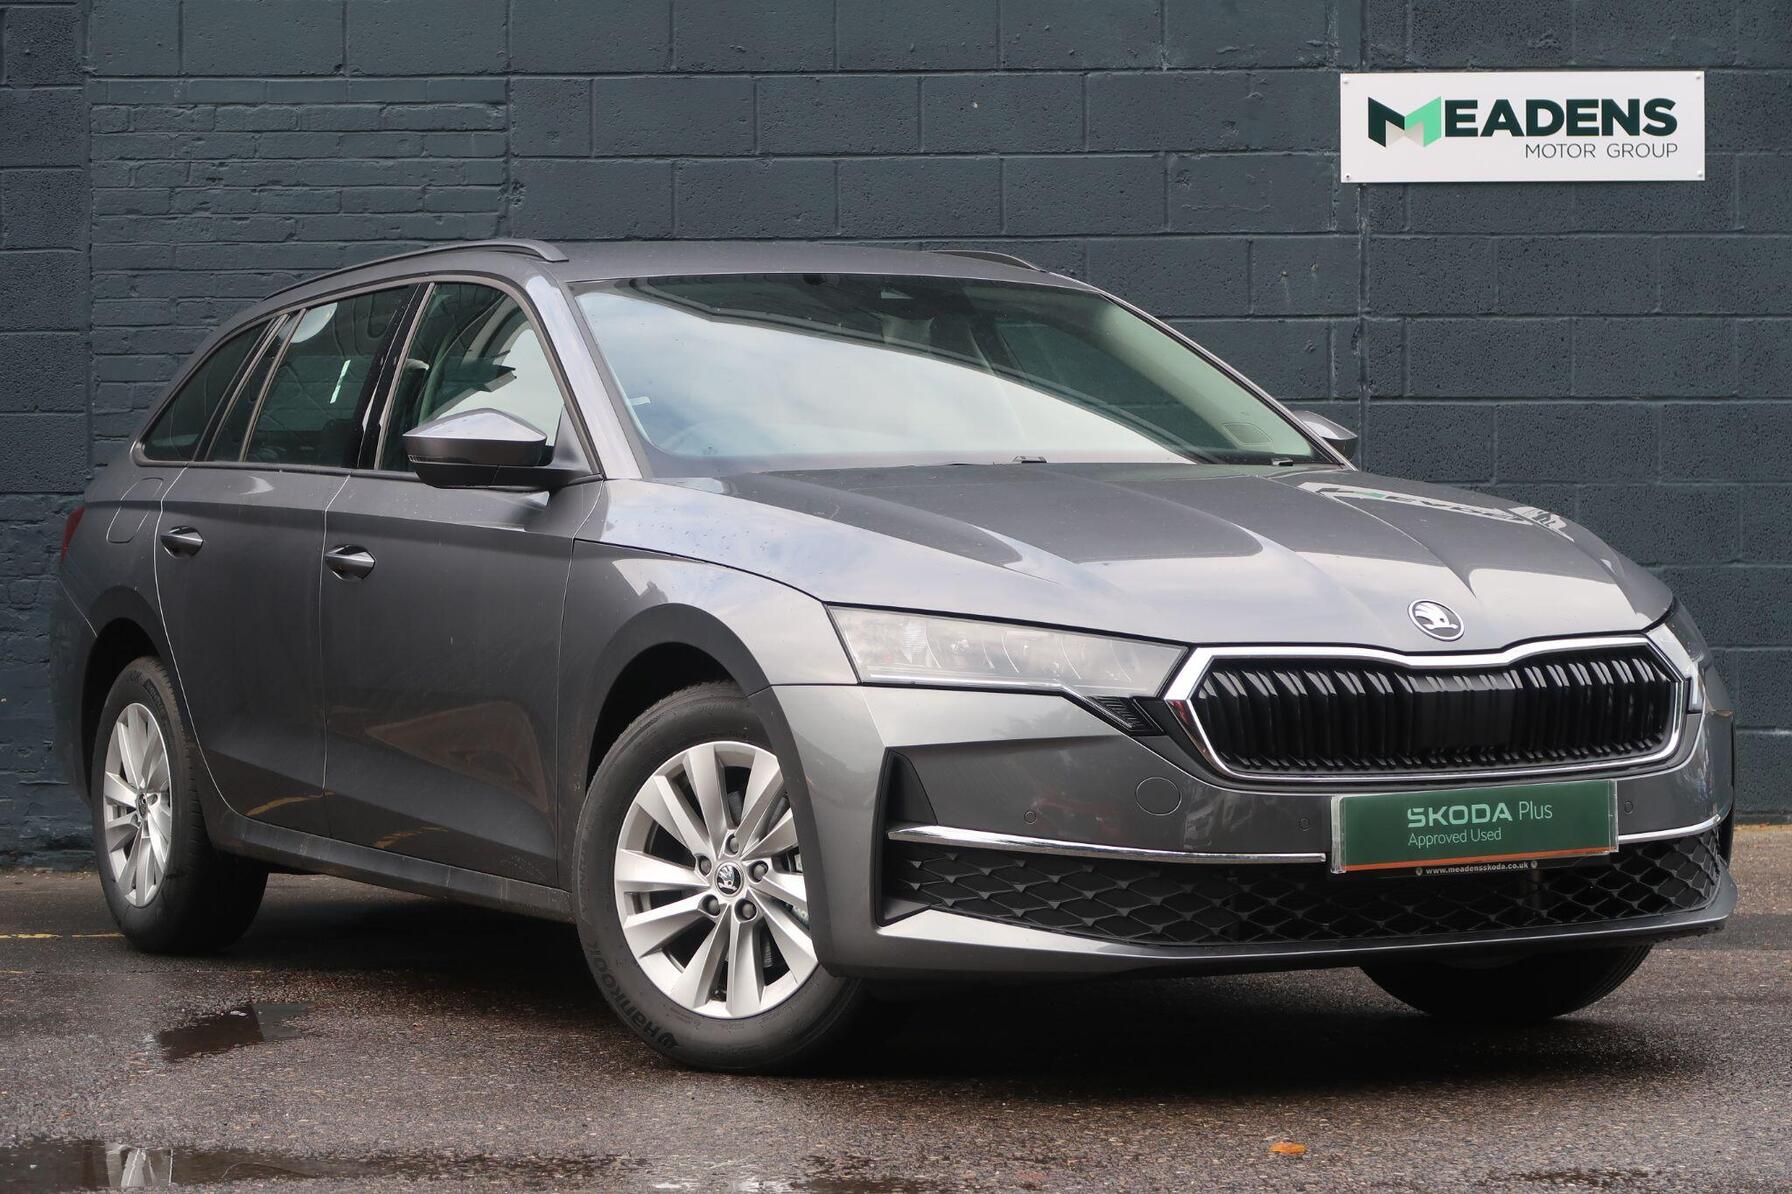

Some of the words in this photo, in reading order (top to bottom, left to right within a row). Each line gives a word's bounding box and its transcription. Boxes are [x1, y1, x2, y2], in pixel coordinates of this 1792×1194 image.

[1368, 96, 1678, 147] MEADENS
[1525, 143, 1596, 159] MOTOR
[1606, 142, 1678, 159] GROUP
[1518, 800, 1553, 821] Plus
[1407, 829, 1468, 849] Approved
[1470, 827, 1502, 842] Used
[1425, 862, 1529, 875] www.meadensskoda.co.uk
